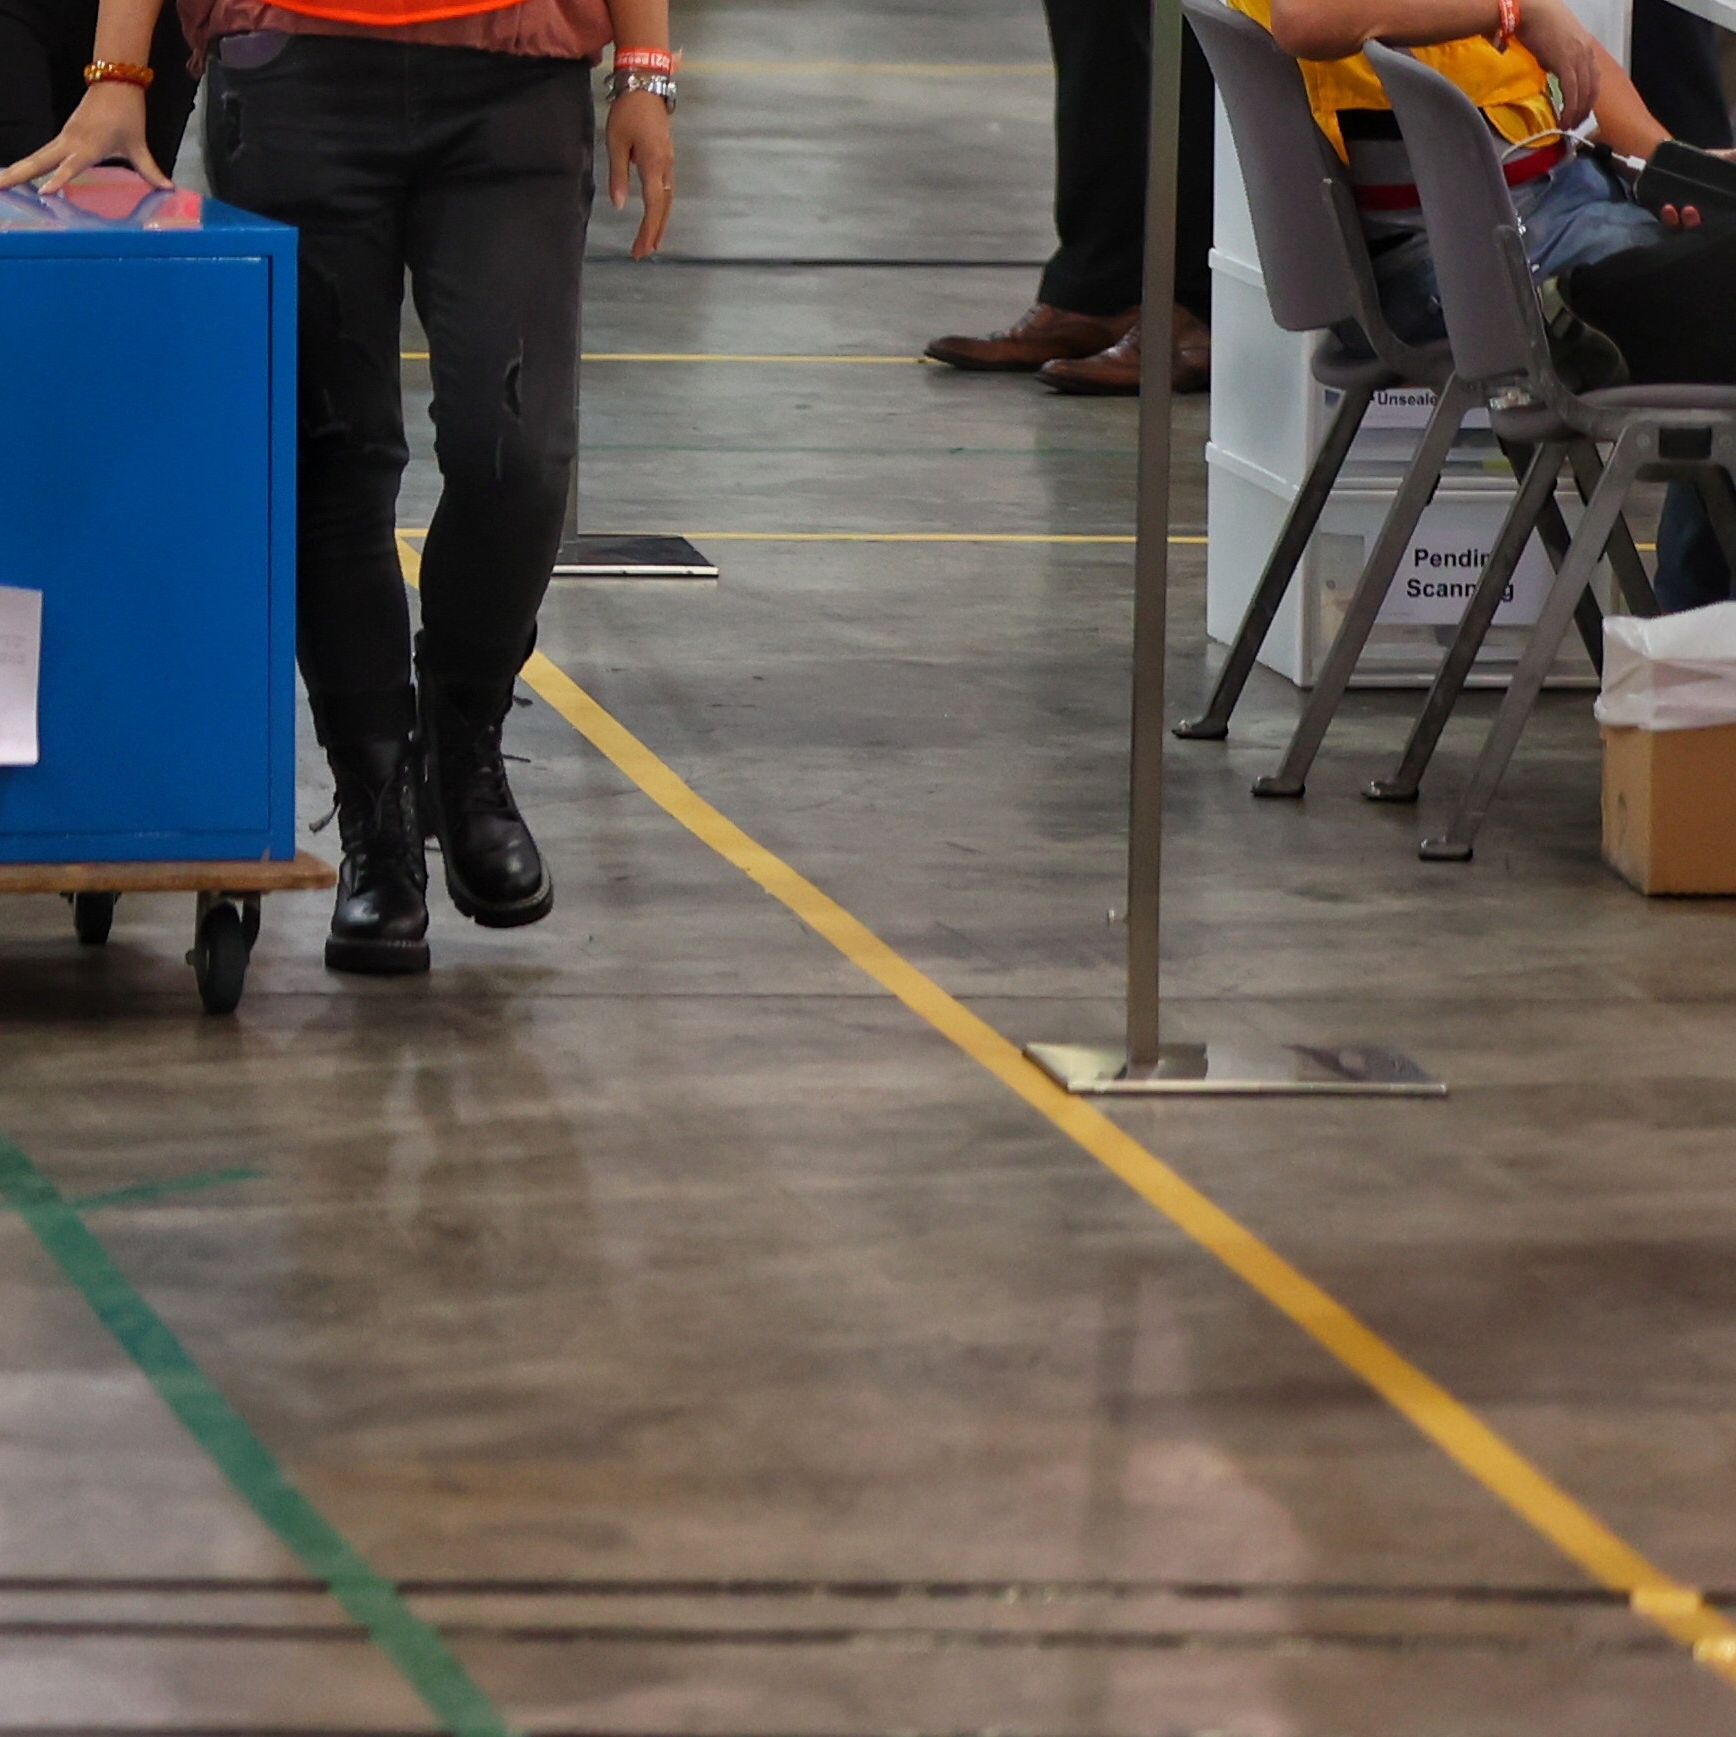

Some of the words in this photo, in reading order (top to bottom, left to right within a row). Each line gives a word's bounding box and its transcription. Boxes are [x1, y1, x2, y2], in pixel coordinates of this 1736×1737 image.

[1377, 391, 1438, 407] Unseale
[1413, 547, 1491, 568] Pendin
[1406, 577, 1514, 603] Scanng
